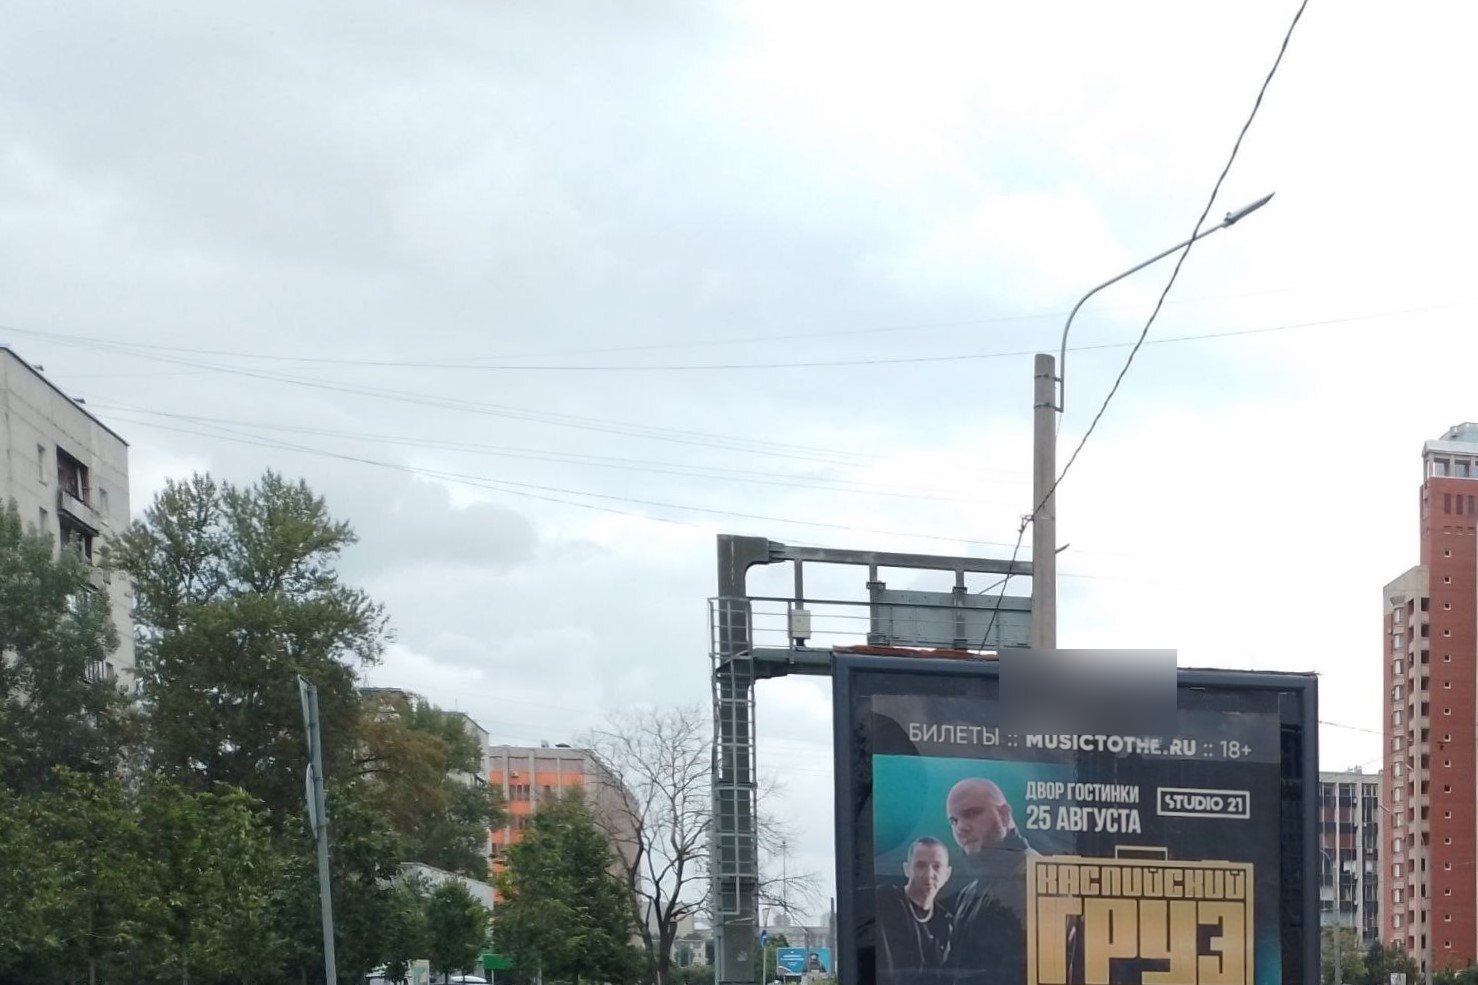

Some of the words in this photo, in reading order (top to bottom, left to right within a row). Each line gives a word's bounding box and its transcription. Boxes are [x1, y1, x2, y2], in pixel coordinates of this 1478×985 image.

[909, 722, 999, 746] БИЛЕТЫ
[1026, 733, 1197, 756] MUSICTOTHE.RU
[1220, 740, 1252, 759] 18+
[1025, 781, 1064, 801] ДВОР
[1067, 783, 1140, 803] ГОСТИНКИ
[1164, 794, 1223, 811] STUDIO
[1226, 797, 1243, 812] 21
[1026, 805, 1051, 830] 25
[1056, 807, 1142, 834] АВГУСТА
[1037, 864, 1245, 899] КАСПИЙСКИЙ
